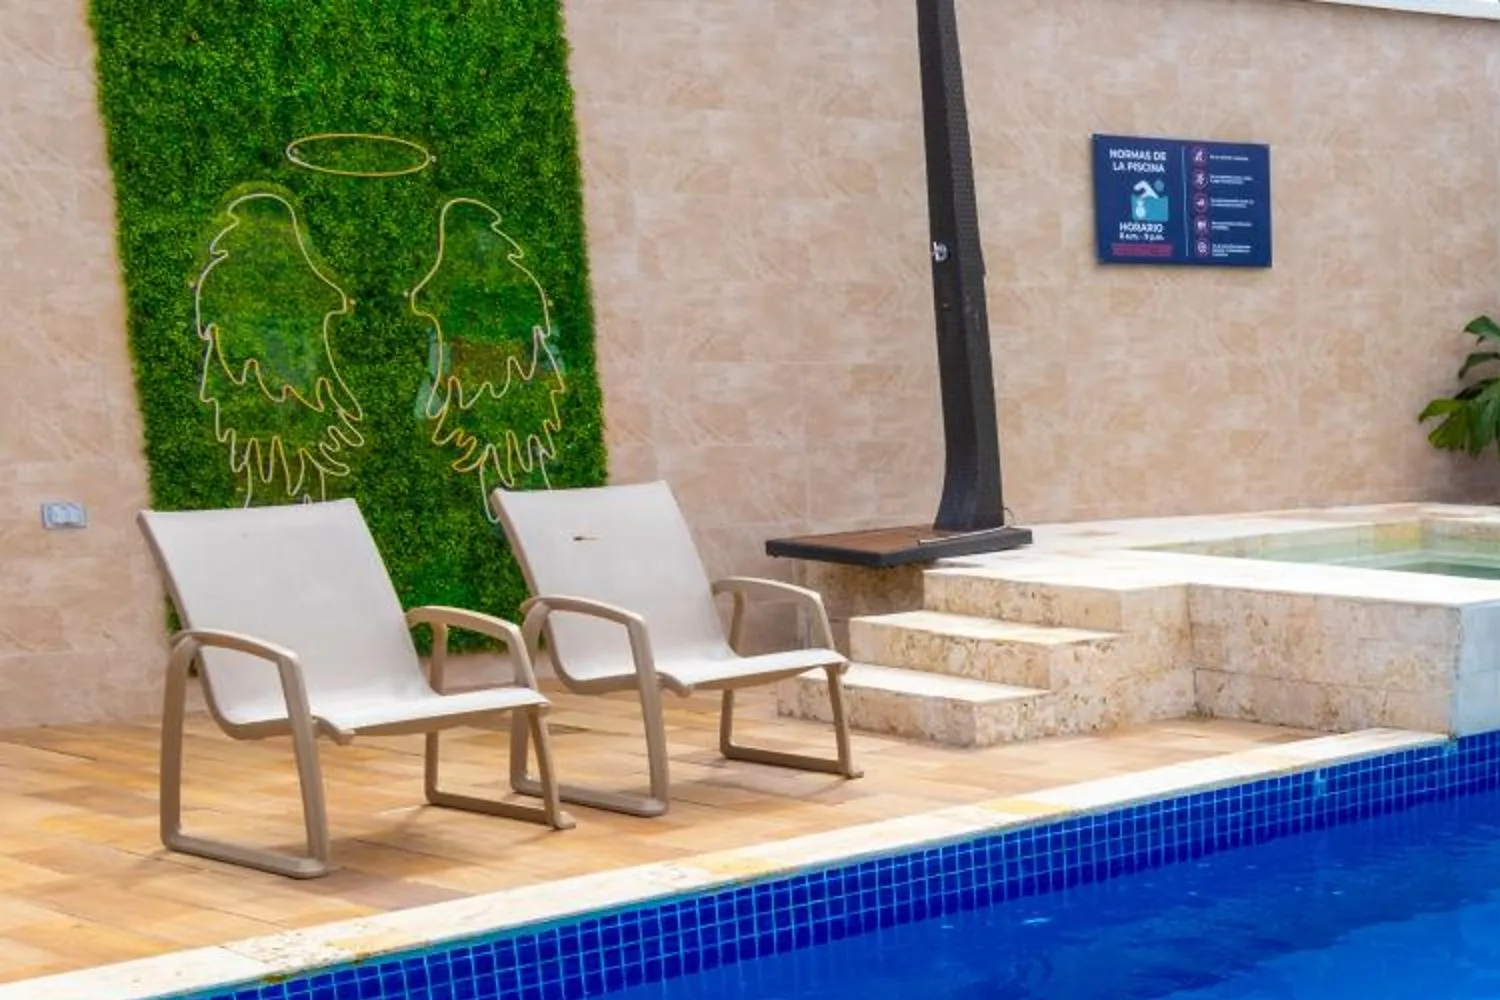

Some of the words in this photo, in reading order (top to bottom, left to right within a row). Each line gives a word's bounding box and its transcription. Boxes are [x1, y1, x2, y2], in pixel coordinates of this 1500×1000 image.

[1109, 148, 1151, 160] NORMAS
[1153, 151, 1167, 161] DE
[1112, 161, 1125, 171] LA
[1127, 161, 1165, 173] PISCINA
